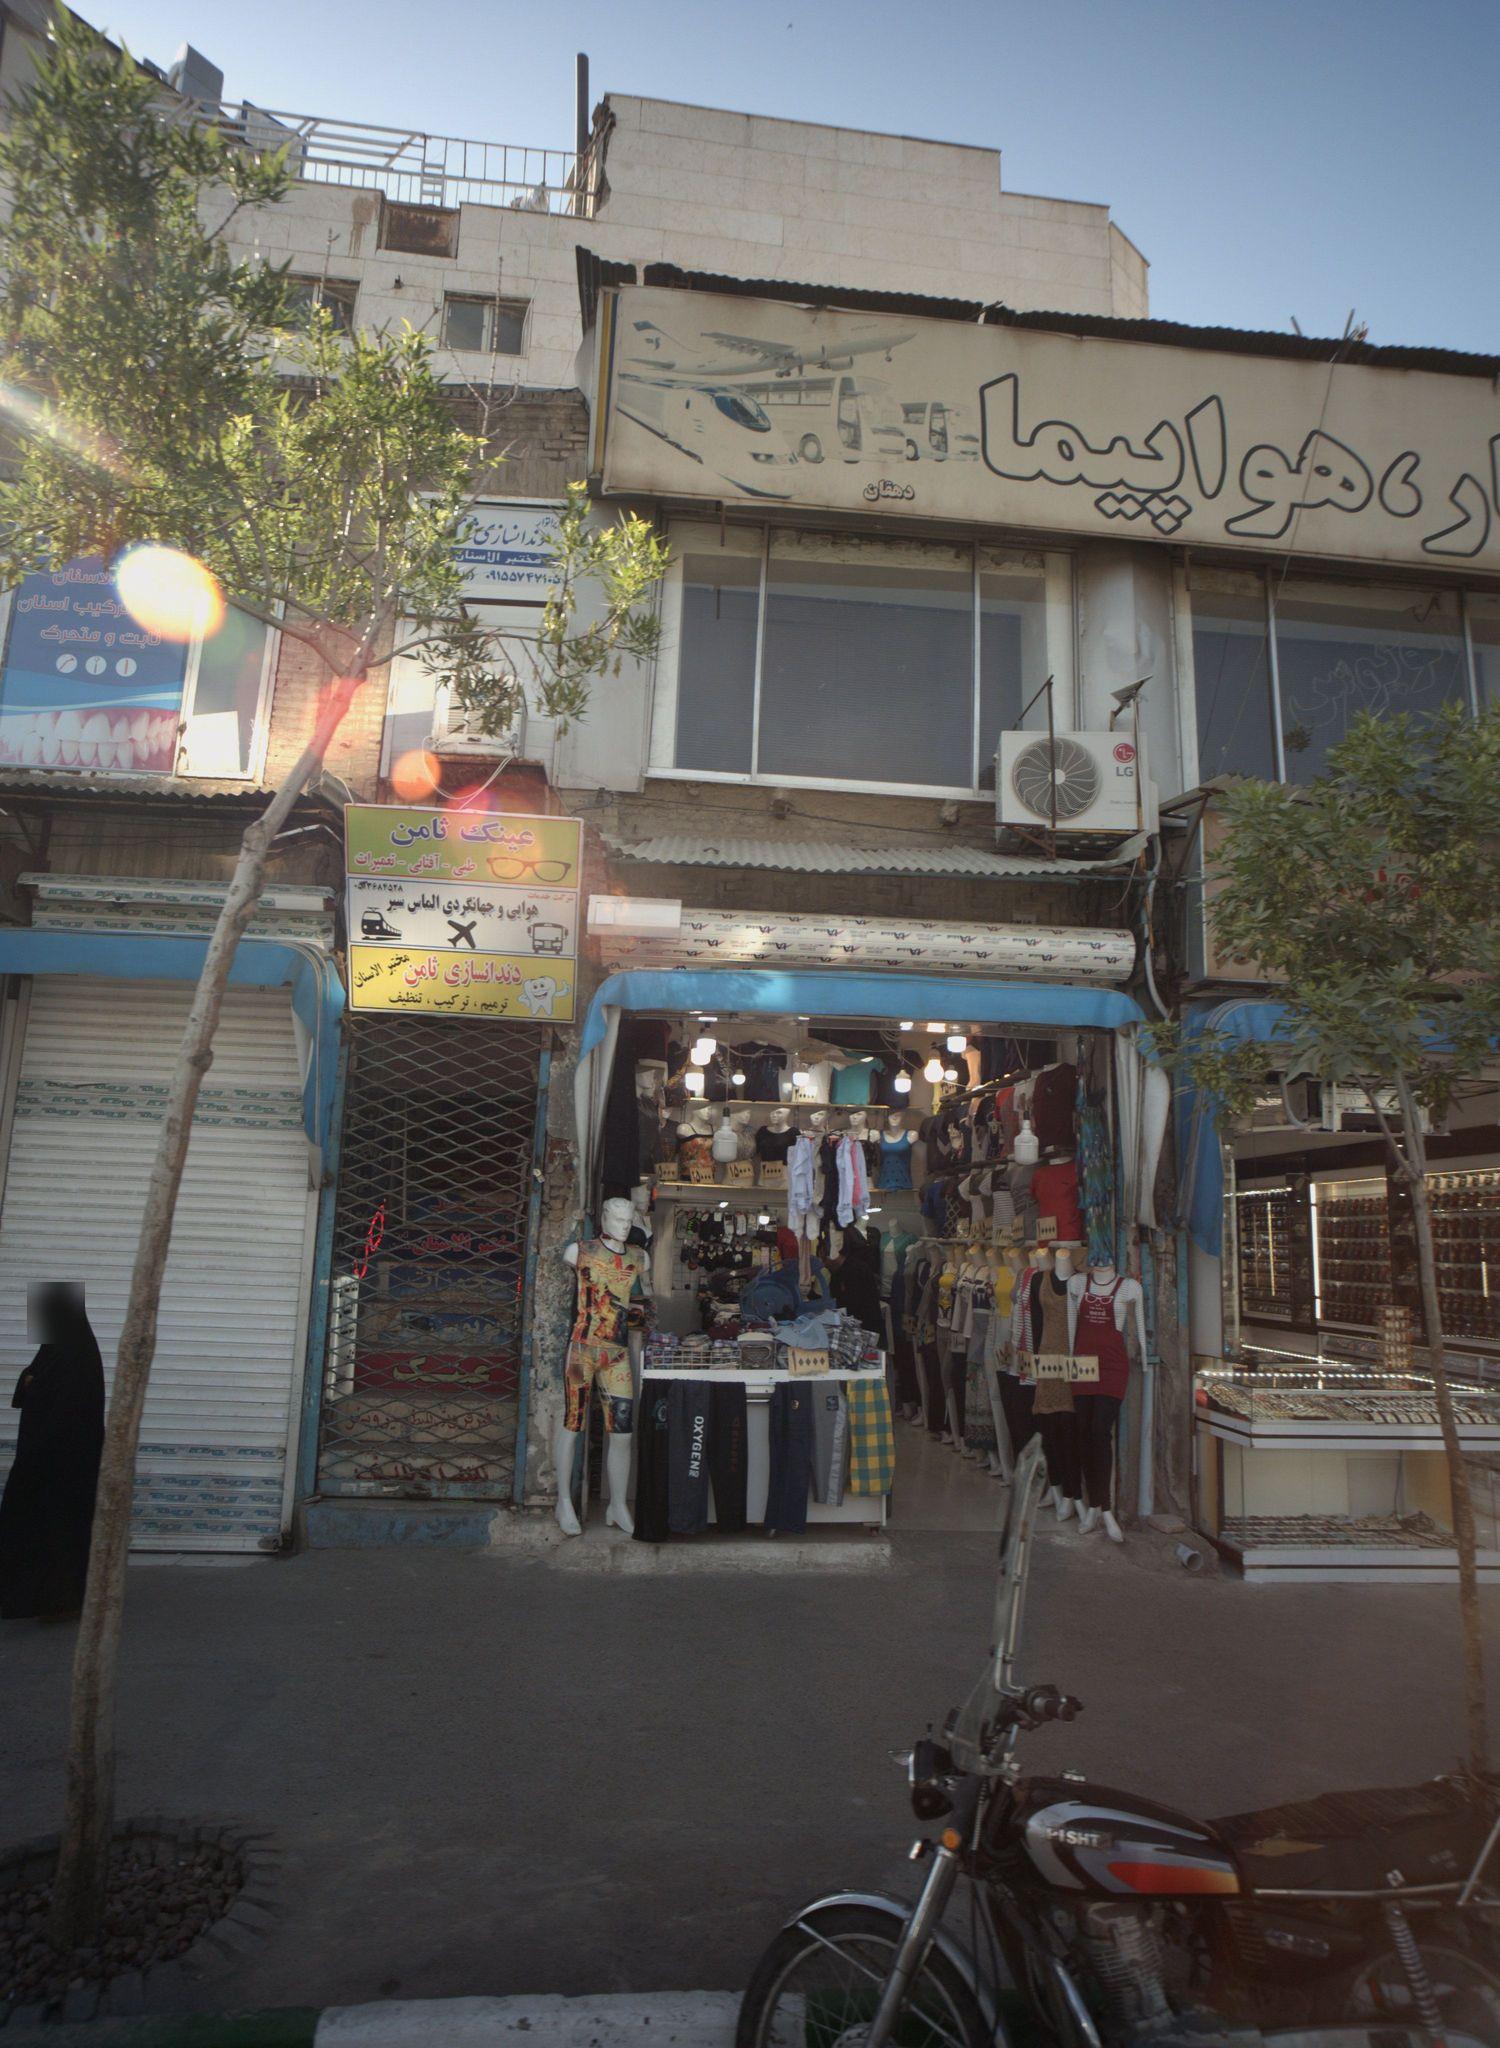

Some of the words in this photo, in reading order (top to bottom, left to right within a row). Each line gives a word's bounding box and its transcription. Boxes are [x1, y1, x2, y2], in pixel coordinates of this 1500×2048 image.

[979, 372, 1374, 538] هواپیما
[863, 479, 915, 501] دهقان
[455, 549, 501, 563] الاسنان
[505, 553, 542, 565] مختبر
[16, 594, 70, 613] اسنان
[40, 624, 101, 644] متحرک
[104, 632, 116, 647] و
[1116, 766, 1134, 777] LG
[390, 816, 449, 848] ثامن
[460, 821, 536, 852] عینک
[355, 850, 397, 872] تعمیرات
[408, 853, 440, 874] آفتابی
[452, 857, 477, 876] طبی
[407, 893, 440, 913] الماس
[442, 896, 494, 917] جهانگردی
[497, 904, 504, 919] و
[507, 900, 539, 920] هوایی
[385, 953, 411, 976] مختبر
[404, 955, 440, 988] ثامن
[443, 958, 524, 987] دندانسازی
[353, 962, 384, 988] الاسنان
[388, 991, 423, 1005] تنظیف
[434, 994, 469, 1012] ترکیب
